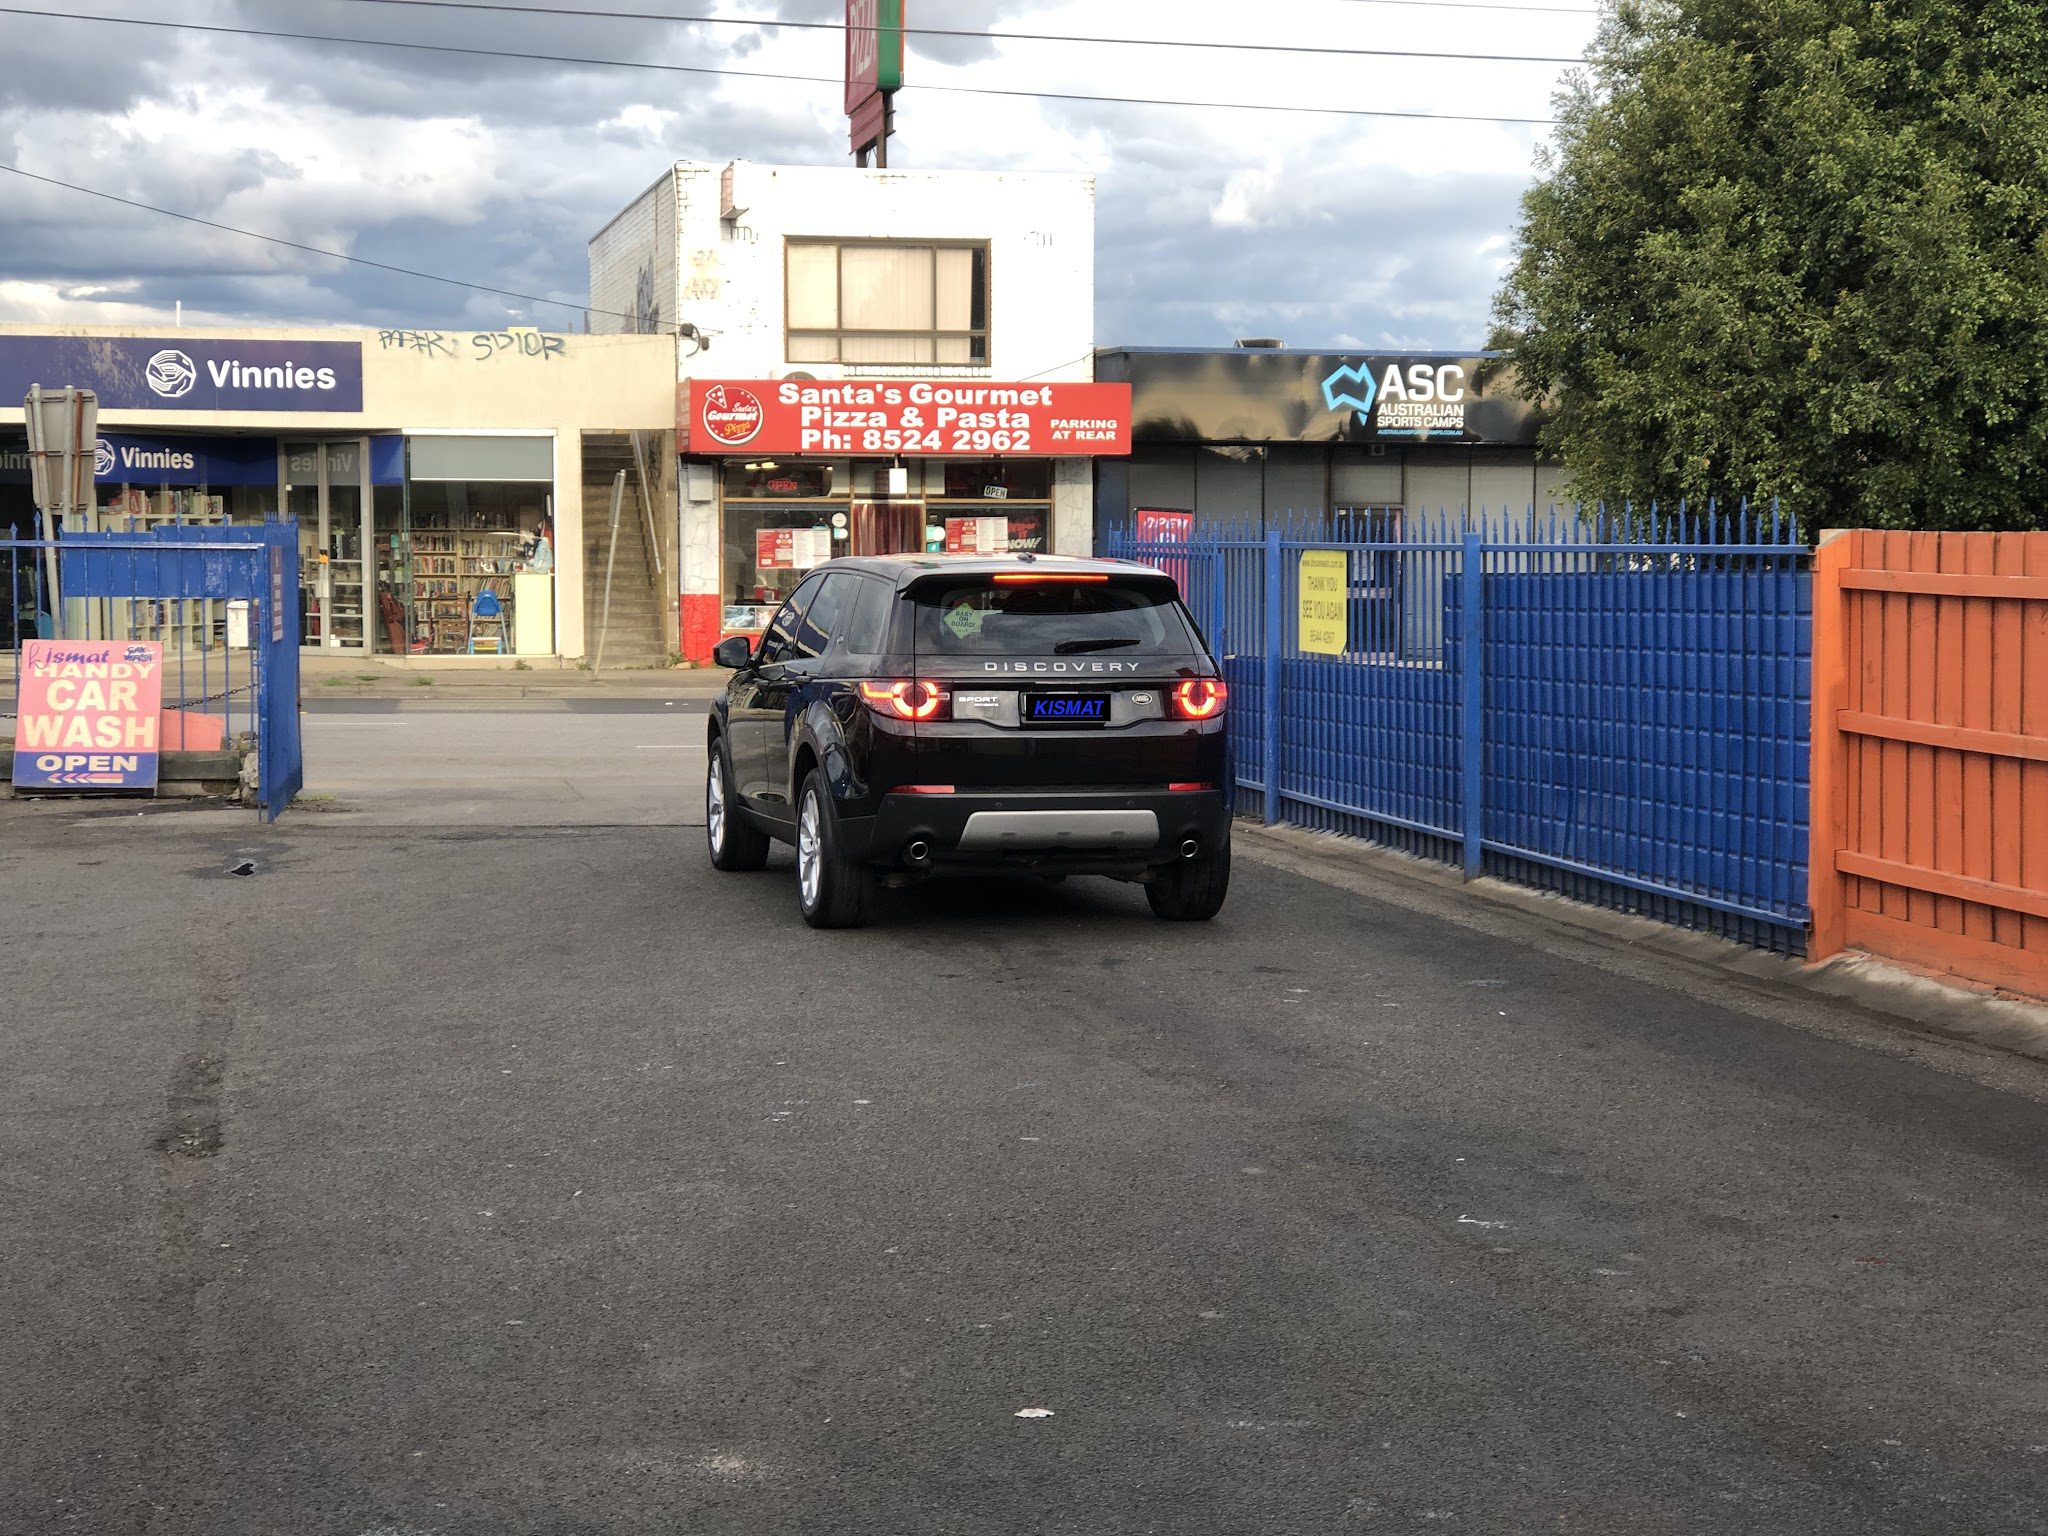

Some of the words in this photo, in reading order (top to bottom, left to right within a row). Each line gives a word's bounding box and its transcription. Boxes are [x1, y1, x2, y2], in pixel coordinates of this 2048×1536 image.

[207, 360, 336, 389] Vinnies
[1378, 364, 1464, 401] ASC
[778, 383, 902, 405] Santa's
[909, 384, 1052, 406] Gourmet
[707, 410, 758, 420] Gourmet
[801, 406, 887, 427] Pizza
[900, 407, 925, 428] &
[937, 407, 1030, 428] Pasta
[1377, 403, 1464, 416] AUSTRALIAN
[1051, 419, 1118, 429] PARKING
[1377, 416, 1422, 427] SPORTS
[1423, 417, 1464, 428] CAMPS
[801, 429, 851, 449] Ph:
[862, 429, 942, 450] 8524
[952, 430, 1030, 450] 2962
[1051, 430, 1072, 440] AT
[1077, 430, 1116, 440] REAR
[121, 447, 195, 469] Vinnies
[985, 486, 1006, 497] OPEN
[1303, 600, 1312, 618] SEE
[34, 663, 156, 678] HANDY
[984, 662, 1139, 671] DISCOVERY
[46, 680, 138, 711] CAR
[23, 715, 155, 748] WASH
[36, 755, 138, 772] OPEN
